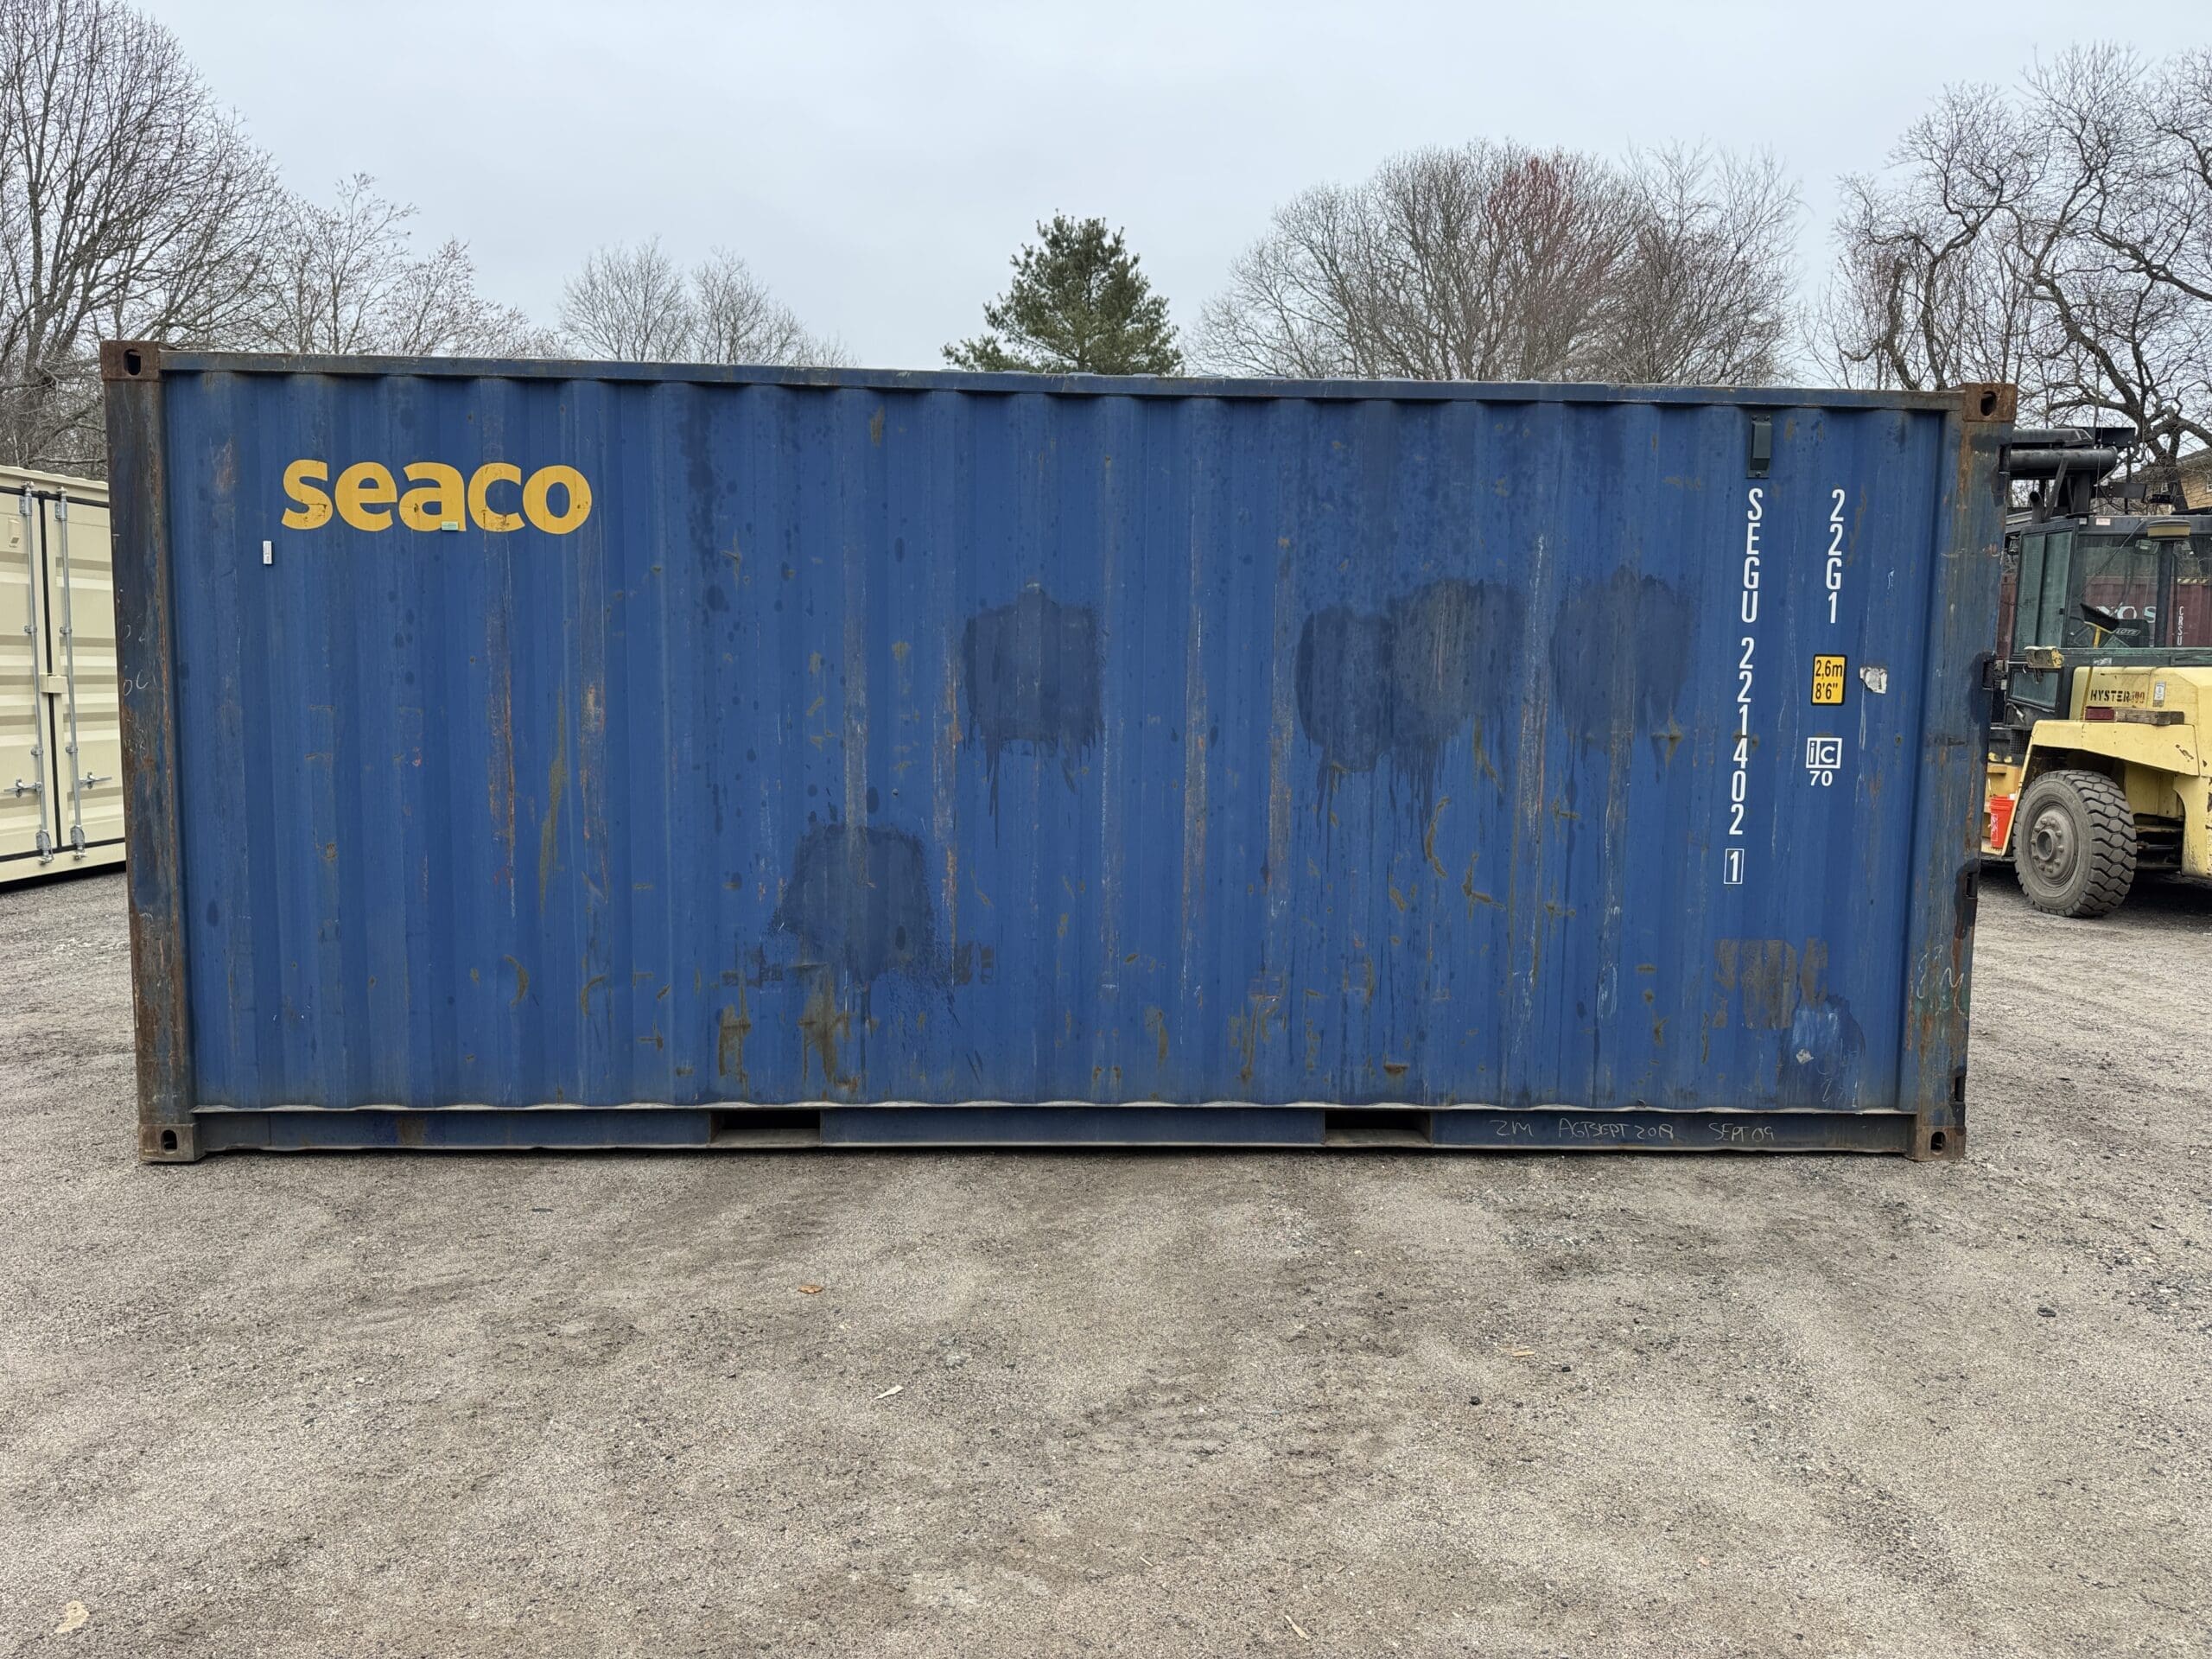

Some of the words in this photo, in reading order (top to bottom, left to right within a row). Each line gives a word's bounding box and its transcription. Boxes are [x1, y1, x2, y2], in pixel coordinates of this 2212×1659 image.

[282, 459, 593, 535] seaco
[1741, 487, 1764, 623] SEGU
[1826, 488, 1847, 624] 22G1
[1729, 637, 1755, 835] 221402
[2089, 689, 2131, 703] HYSTER
[1809, 770, 1833, 786] 70
